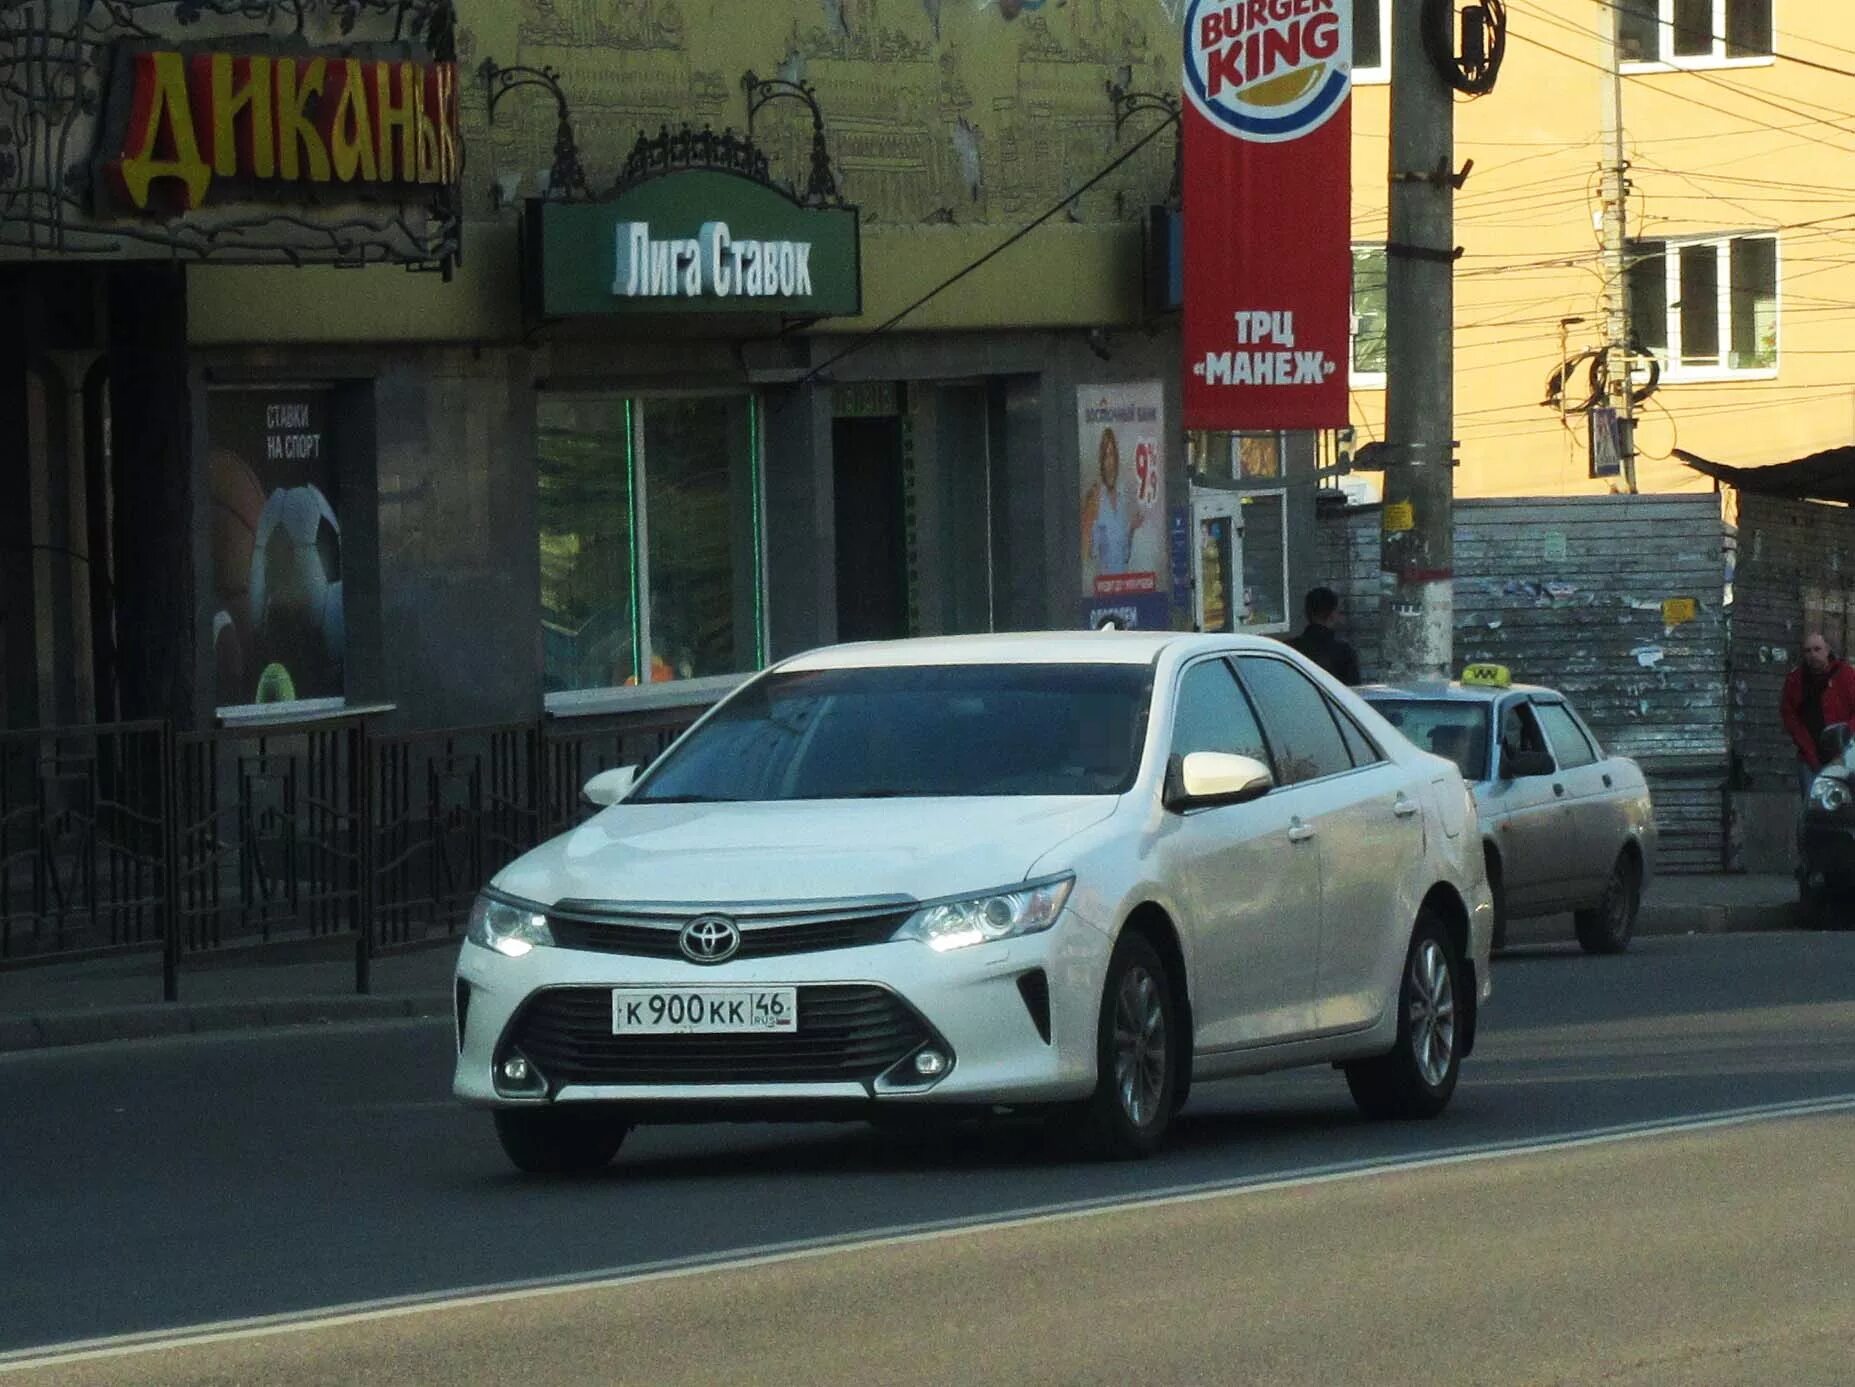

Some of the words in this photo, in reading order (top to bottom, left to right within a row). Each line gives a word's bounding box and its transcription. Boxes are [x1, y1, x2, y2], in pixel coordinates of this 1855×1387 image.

[1207, 12, 1339, 97] KING
[616, 222, 702, 296] Лига
[708, 222, 812, 296] Ставок
[1234, 310, 1295, 348] ТРЦ
[1193, 351, 1336, 385] «МАНЕЖ»
[266, 403, 309, 428] СТАВКИ
[266, 435, 283, 459] НА
[285, 433, 320, 459] СПОРТ
[756, 992, 785, 1015] 46
